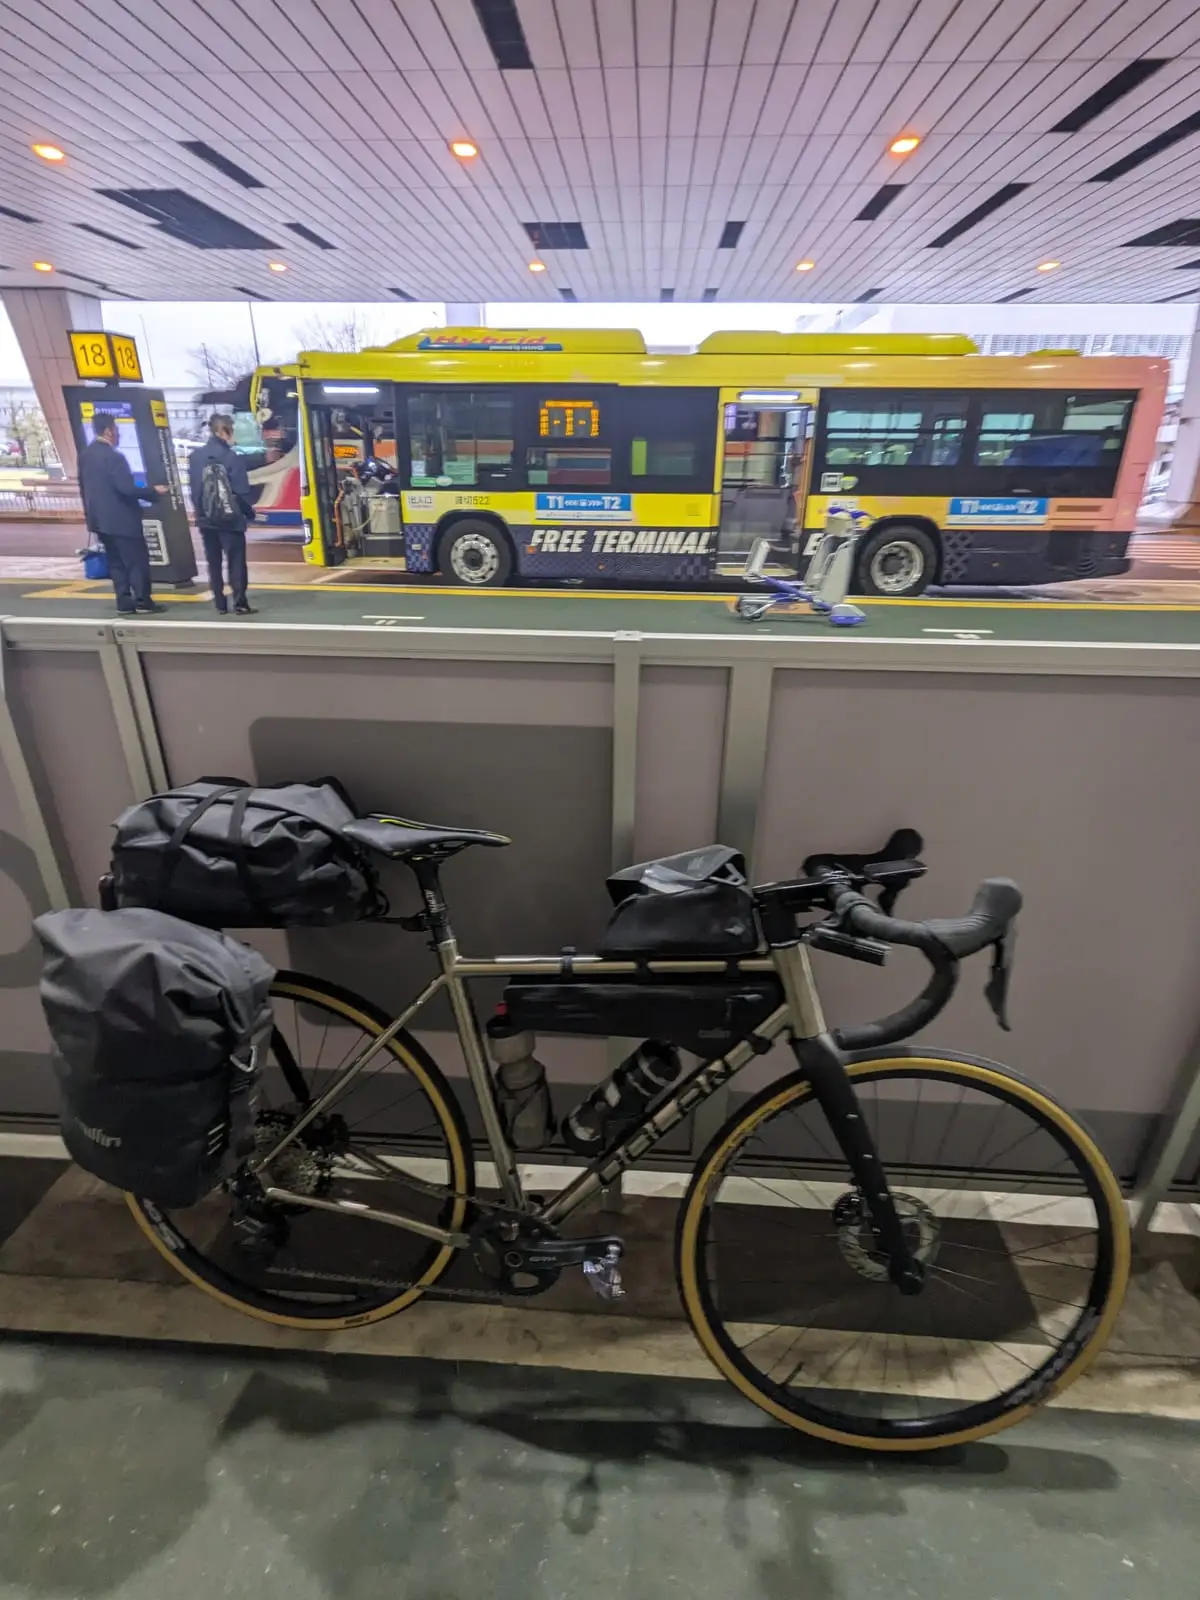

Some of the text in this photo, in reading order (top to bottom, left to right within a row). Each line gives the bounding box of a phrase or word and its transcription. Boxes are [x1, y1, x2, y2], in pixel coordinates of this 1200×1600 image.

[79, 343, 106, 367] 18
[117, 346, 136, 370] 18
[546, 495, 565, 509] T1
[601, 496, 621, 510] T2
[530, 529, 588, 553] FREE
[591, 530, 712, 554] TERMINAL
